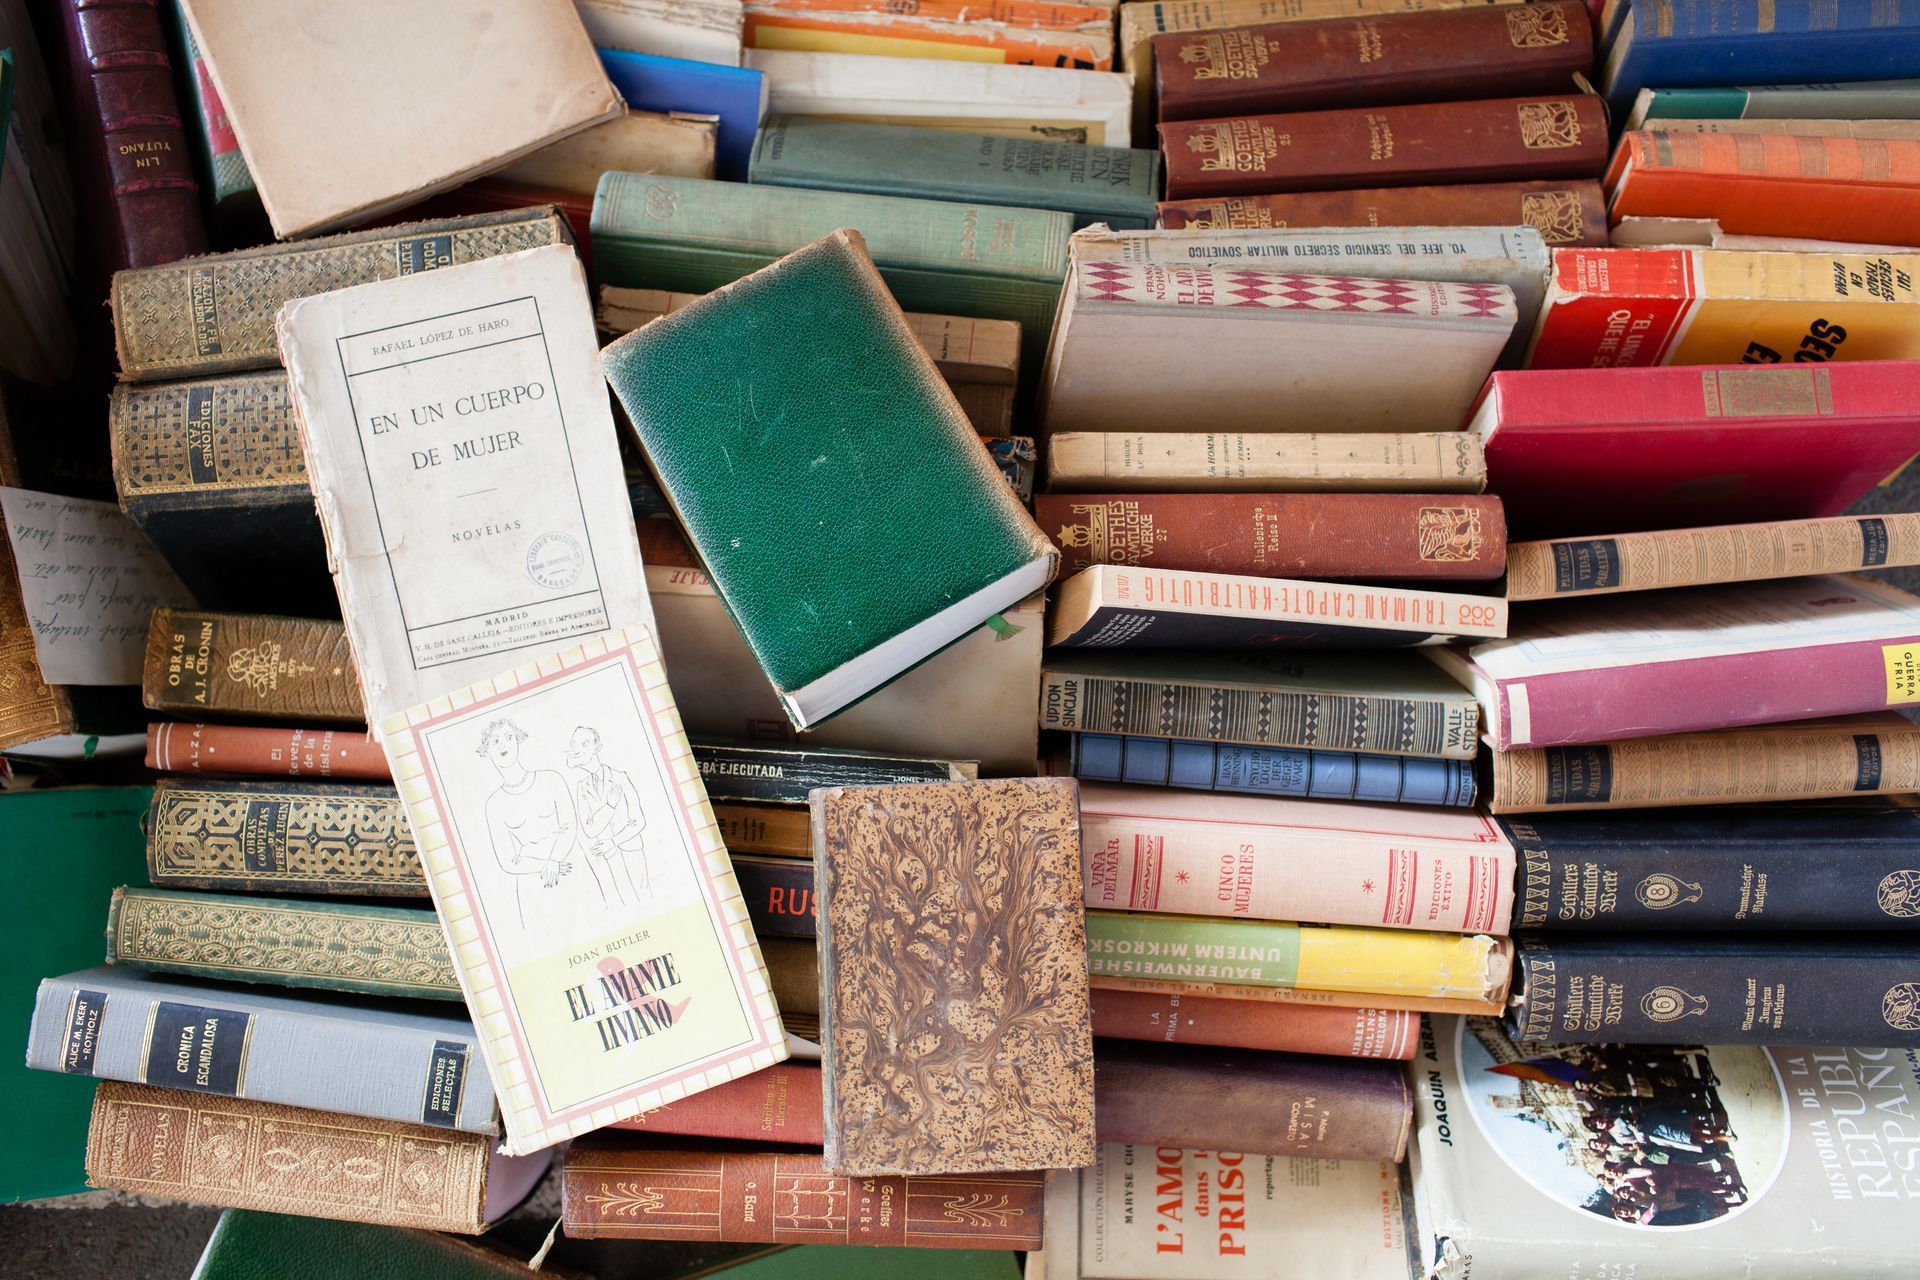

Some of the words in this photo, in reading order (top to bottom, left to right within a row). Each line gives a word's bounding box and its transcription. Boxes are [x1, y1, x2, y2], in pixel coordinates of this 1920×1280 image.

[120, 141, 172, 154] YUTANG
[1230, 120, 1252, 172] GOETHES
[1262, 126, 1278, 158] WERKE
[136, 156, 162, 168] LIN
[1188, 246, 1242, 258] SOVIETICO
[1246, 245, 1289, 257] MILITAR
[1294, 244, 1340, 256] SECRETO
[1346, 243, 1392, 255] SERVICIO
[1400, 244, 1416, 255] DEL
[1421, 244, 1444, 255] JEFE
[201, 275, 214, 315] RAZON
[1850, 272, 1863, 289] EN
[1177, 291, 1194, 305] EL
[1198, 289, 1215, 305] DE
[372, 339, 415, 356] RAFAEL
[420, 329, 454, 346] LÓPEZ
[458, 326, 474, 337] DE
[478, 318, 510, 333] HARO
[1605, 309, 1631, 336] QUE
[1601, 337, 1620, 353] HE
[370, 412, 400, 435] EN
[411, 402, 444, 426] UN
[455, 382, 545, 416] CUERPO
[189, 420, 200, 449] FAX
[200, 401, 214, 468] EDICIONES
[412, 448, 442, 470] DE
[453, 430, 525, 461] MUJER
[452, 520, 522, 543] NOVELAS
[1140, 513, 1154, 558] WERKE
[1156, 528, 1168, 542] 27
[1268, 524, 1279, 552] Reise
[1877, 525, 1885, 554] EDITOR
[1558, 544, 1570, 588] PLUTARCO
[1578, 547, 1591, 581] VIDAS
[1592, 541, 1609, 587] PARALELAS
[484, 611, 529, 627] MADRID
[1365, 594, 1446, 625] TRUMAN
[434, 640, 445, 649] DE
[446, 635, 466, 647] SANZ
[555, 607, 602, 623] IMPRESORES
[169, 634, 185, 686] OBRAS
[185, 653, 195, 670] DE
[198, 621, 213, 676] CRONIN
[269, 644, 281, 690] MAESTROS
[279, 660, 287, 673] DE
[288, 659, 297, 678] HOY
[1894, 661, 1903, 690] FRIA
[1905, 652, 1915, 697] GUERRA
[195, 687, 206, 703] A.
[1047, 684, 1062, 723] UPTON
[1063, 680, 1078, 727] SINCLAIR
[305, 737, 316, 751] la
[1463, 707, 1479, 751] STREET
[271, 748, 282, 761] El
[304, 753, 313, 768] de
[720, 762, 784, 779] EJECUTADA
[1222, 755, 1232, 779] HANS
[893, 774, 920, 784] LIONEL
[1271, 761, 1281, 781] DER
[1292, 759, 1303, 786] WART
[1571, 759, 1583, 792] VIDAS
[246, 818, 257, 855] OBRAS
[257, 807, 270, 867] COMPLETAS
[268, 831, 275, 844] DE
[275, 834, 287, 873] PEREZ
[1091, 850, 1105, 887] VIÑA
[1103, 838, 1120, 902] DELMAR
[1218, 854, 1235, 902] CINCO
[1234, 843, 1254, 913] MUJERES
[1429, 859, 1443, 921] EDICIONES
[123, 902, 137, 954] NOVELAS
[568, 947, 600, 968] JOAN
[605, 929, 651, 953] BUTLER
[1195, 943, 1281, 963] UNTERM
[564, 984, 596, 1022] EL
[598, 952, 682, 1010] AMANTE
[1273, 990, 1334, 1002] BERNARD
[76, 999, 88, 1026] EKERT
[595, 998, 673, 1052] LIVIANO
[1151, 1011, 1160, 1025] LA
[1165, 1012, 1178, 1041] PRIMA
[75, 1027, 84, 1039] M.
[1362, 1008, 1376, 1057] MOLINS
[68, 1040, 80, 1068] ALICE
[177, 1025, 196, 1073] CRONICA
[196, 1017, 219, 1086] ESCANDALOSA
[1788, 1057, 1809, 1076] LA
[431, 1056, 446, 1112] EDICIONES
[441, 1059, 458, 1112] SELECTAS
[1799, 1087, 1821, 1108] DE
[1286, 1102, 1301, 1142] COMPLETO
[1428, 1071, 1453, 1147] JOAQUIN
[151, 1112, 171, 1178] NOVELAS
[1808, 1119, 1853, 1200] HISTORIA
[744, 1194, 757, 1222] Band
[1125, 1172, 1134, 1225] MARYSE
[1194, 1171, 1209, 1217] dans
[1095, 1193, 1105, 1262] COLLECTION
[1381, 1188, 1392, 1249] EDITIONS
